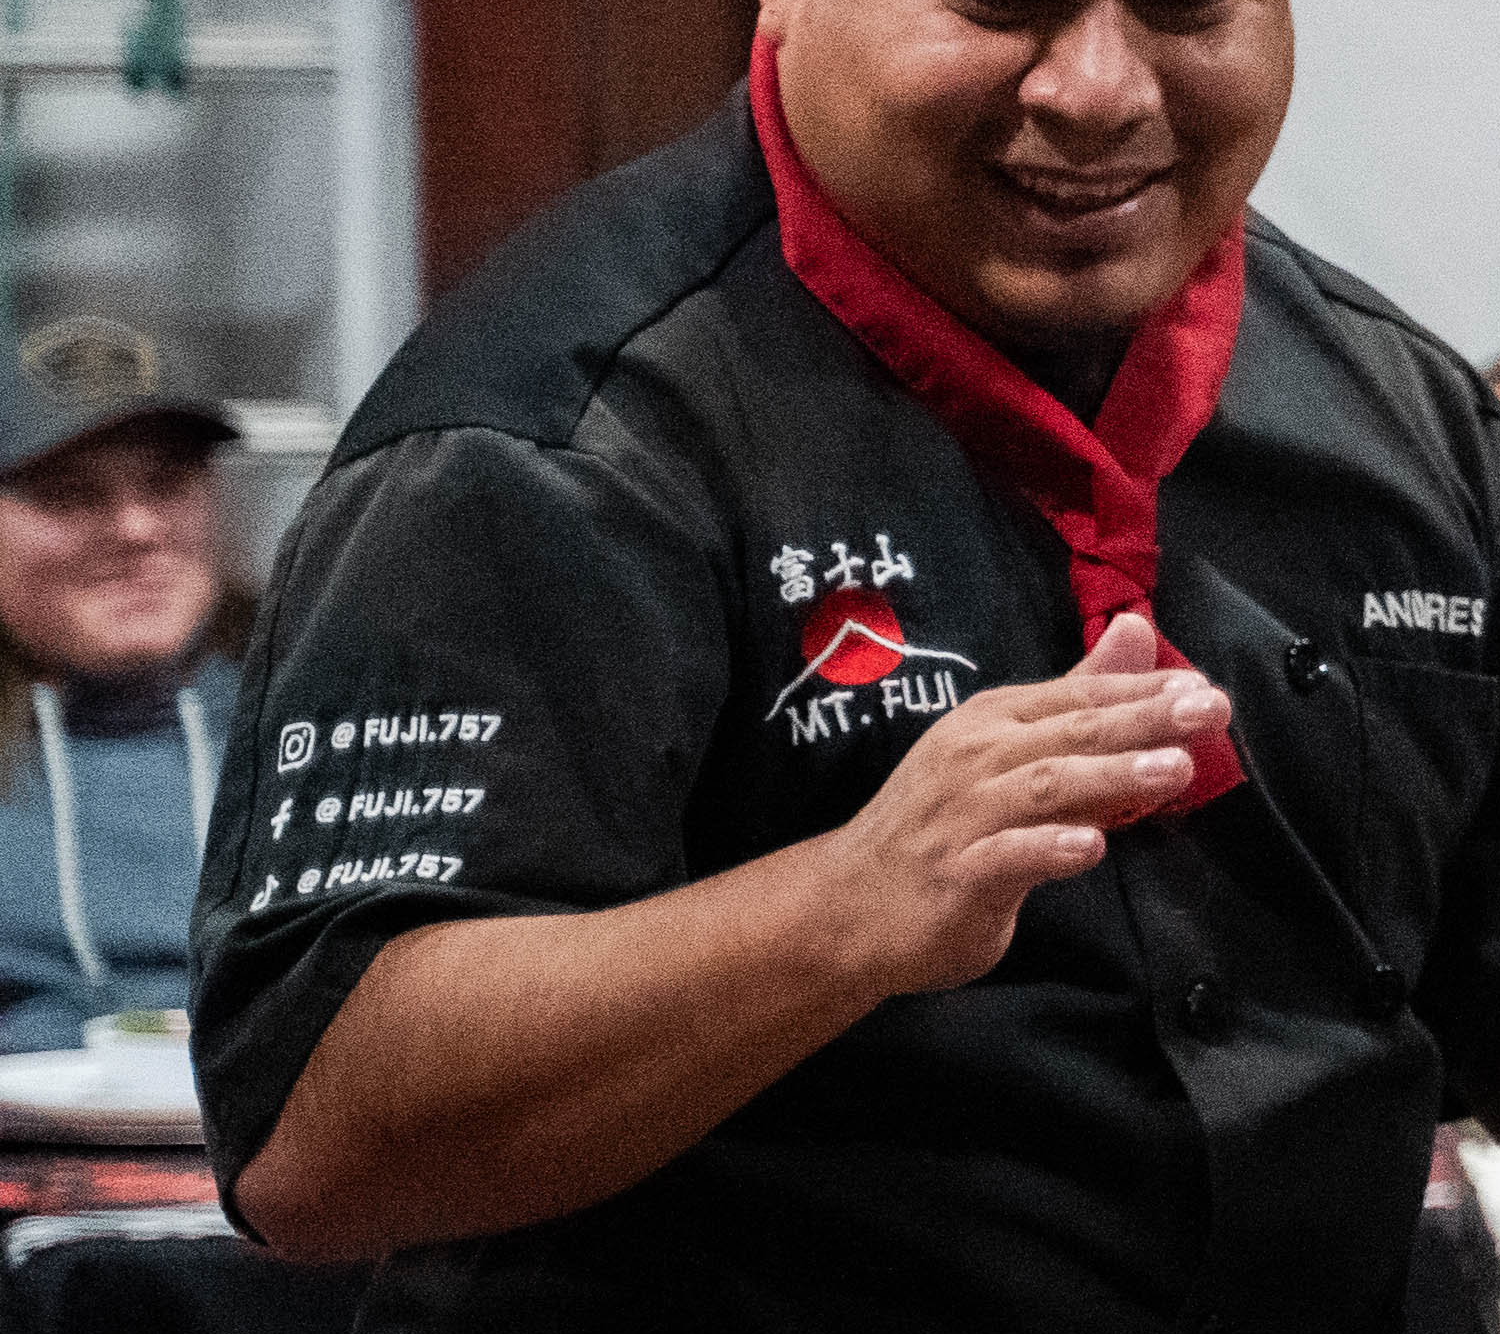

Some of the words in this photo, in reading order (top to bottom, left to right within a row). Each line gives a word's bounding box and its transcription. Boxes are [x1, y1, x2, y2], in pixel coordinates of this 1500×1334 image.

[771, 534, 914, 603] 富士山
[363, 713, 501, 744] FUJI.757
[785, 691, 872, 746] MT.
[880, 670, 959, 719] FUJI
[348, 788, 485, 821] FUJI.757
